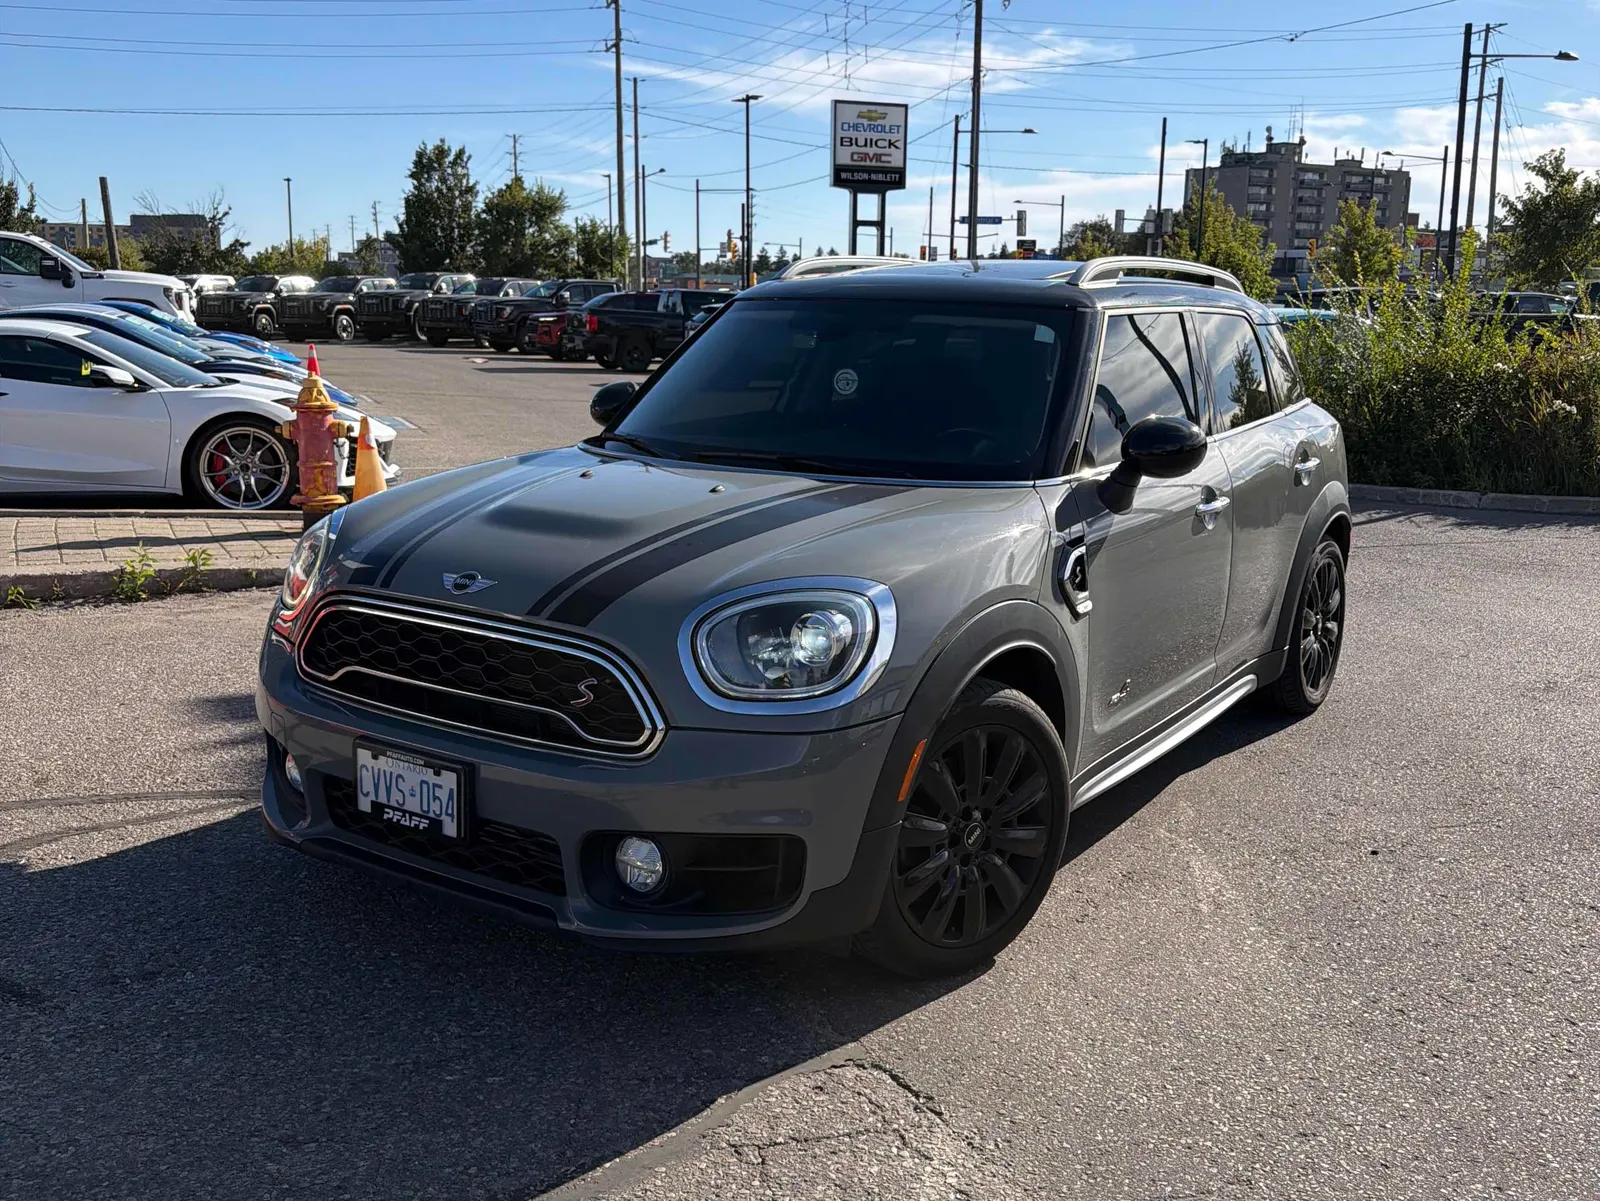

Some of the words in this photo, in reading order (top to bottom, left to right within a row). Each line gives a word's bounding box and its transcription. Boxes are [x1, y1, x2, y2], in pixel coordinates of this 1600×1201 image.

[841, 122, 901, 134] CHEVROLET
[840, 136, 901, 150] BUICK
[850, 152, 892, 164] GMC
[841, 172, 900, 182] WILSON-NIBLETT
[455, 577, 475, 586] MINI
[570, 677, 598, 708] S
[386, 750, 425, 766] PFAFFAUTO.COM
[359, 763, 406, 808] CVVS
[419, 778, 455, 823] 054
[383, 807, 429, 830] PFAFF
